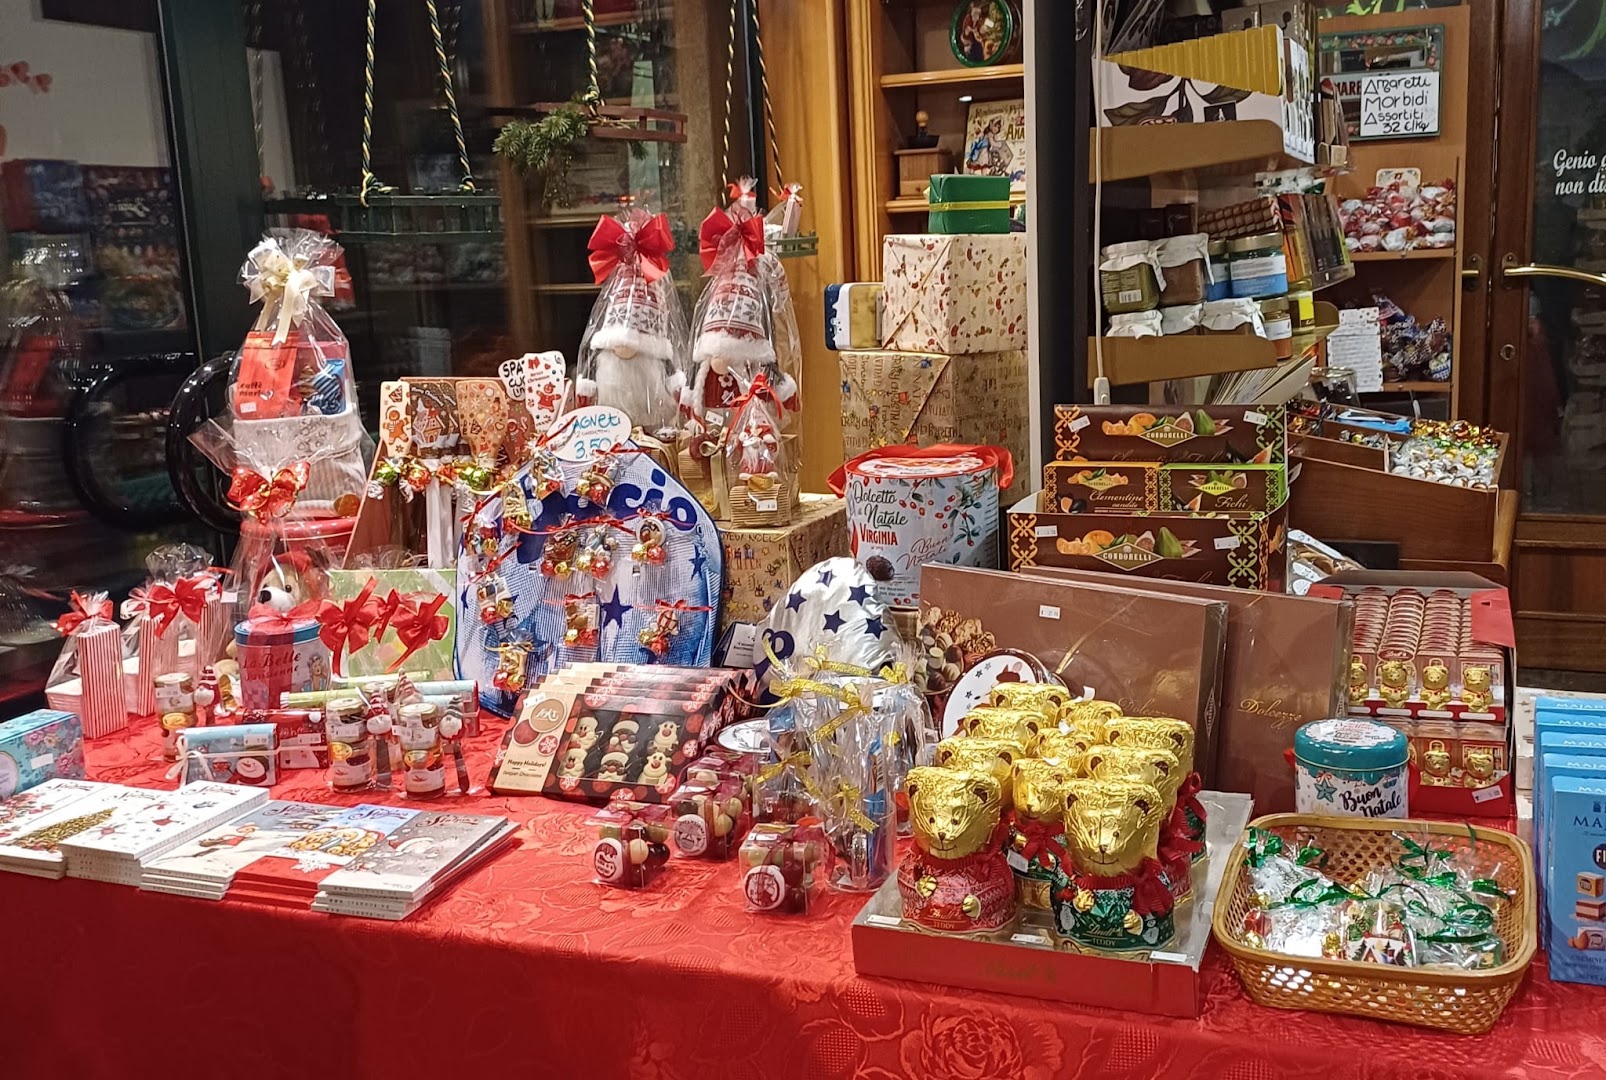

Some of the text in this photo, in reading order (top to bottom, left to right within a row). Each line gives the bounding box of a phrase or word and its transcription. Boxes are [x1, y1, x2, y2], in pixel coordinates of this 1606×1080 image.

[1364, 76, 1431, 96] Amaretti
[1365, 91, 1429, 112] Morbidi
[1364, 108, 1424, 126] Assortiti
[1382, 121, 1400, 134] 32
[1553, 148, 1597, 177] Genio
[1555, 180, 1585, 196] non
[503, 360, 525, 378] SPA
[852, 480, 897, 504] Dolcetto
[1089, 490, 1144, 506] Clementine
[1214, 495, 1248, 508] Fichi
[864, 503, 909, 530] Natale
[859, 523, 898, 546] VIRGINIA
[896, 547, 947, 571] Natale
[1103, 552, 1153, 562] CONDORELLI
[261, 650, 302, 668] Belle
[1237, 697, 1303, 730] Dolcezze
[507, 758, 523, 768] Happy
[1338, 787, 1382, 812] Buon
[1359, 790, 1402, 818] Natale
[1086, 923, 1116, 936] Lindt
[1092, 938, 1116, 946] TEDDY
